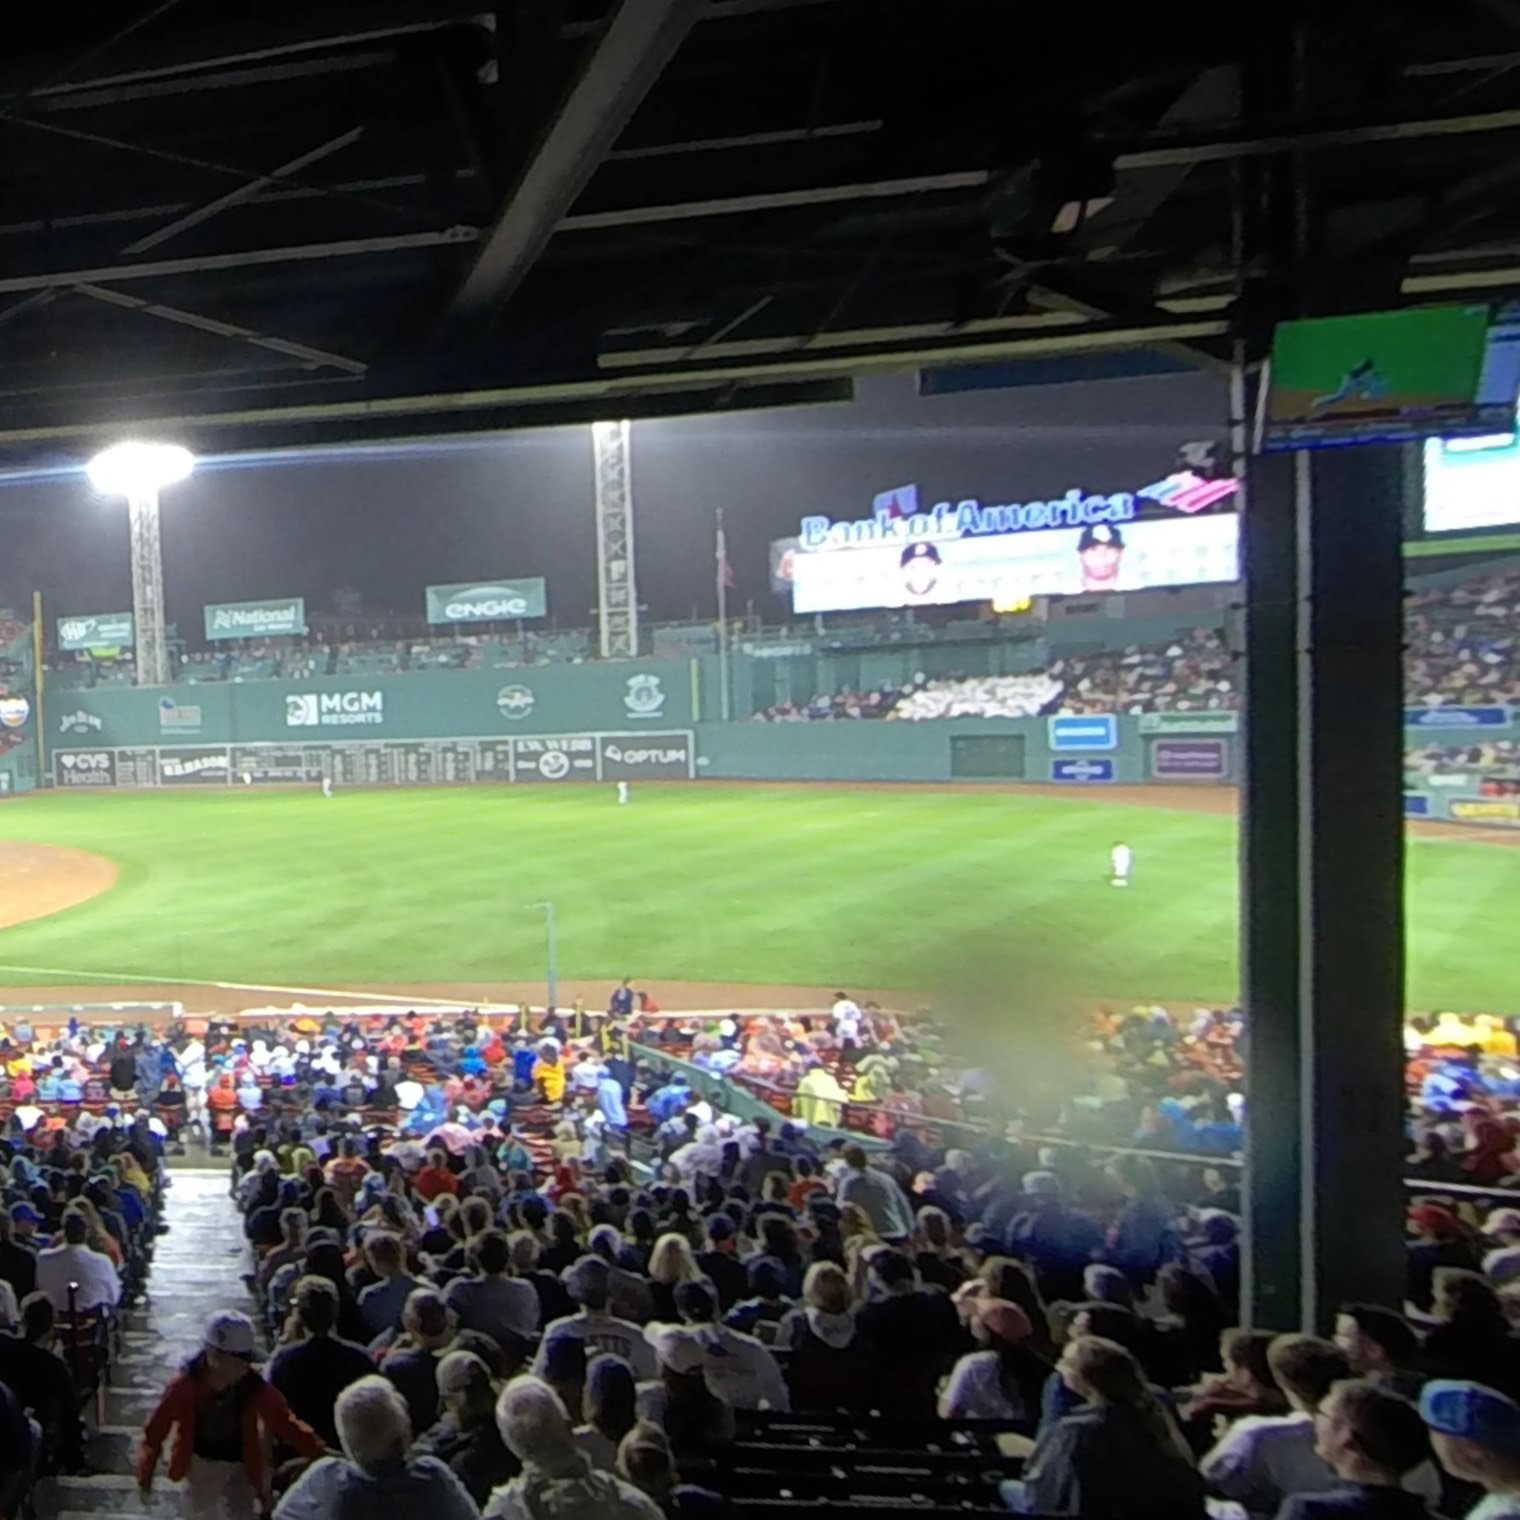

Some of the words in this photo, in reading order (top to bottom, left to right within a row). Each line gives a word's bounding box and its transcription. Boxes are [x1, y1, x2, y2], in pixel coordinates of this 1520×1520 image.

[800, 510, 901, 551] Bank
[908, 502, 950, 536] of
[957, 488, 1135, 534] America
[232, 606, 295, 624] National
[321, 691, 382, 713] MGM
[321, 712, 383, 725] RESORTS
[76, 754, 110, 769] CVS
[623, 750, 686, 764] OPTUM
[63, 769, 111, 784] Health
